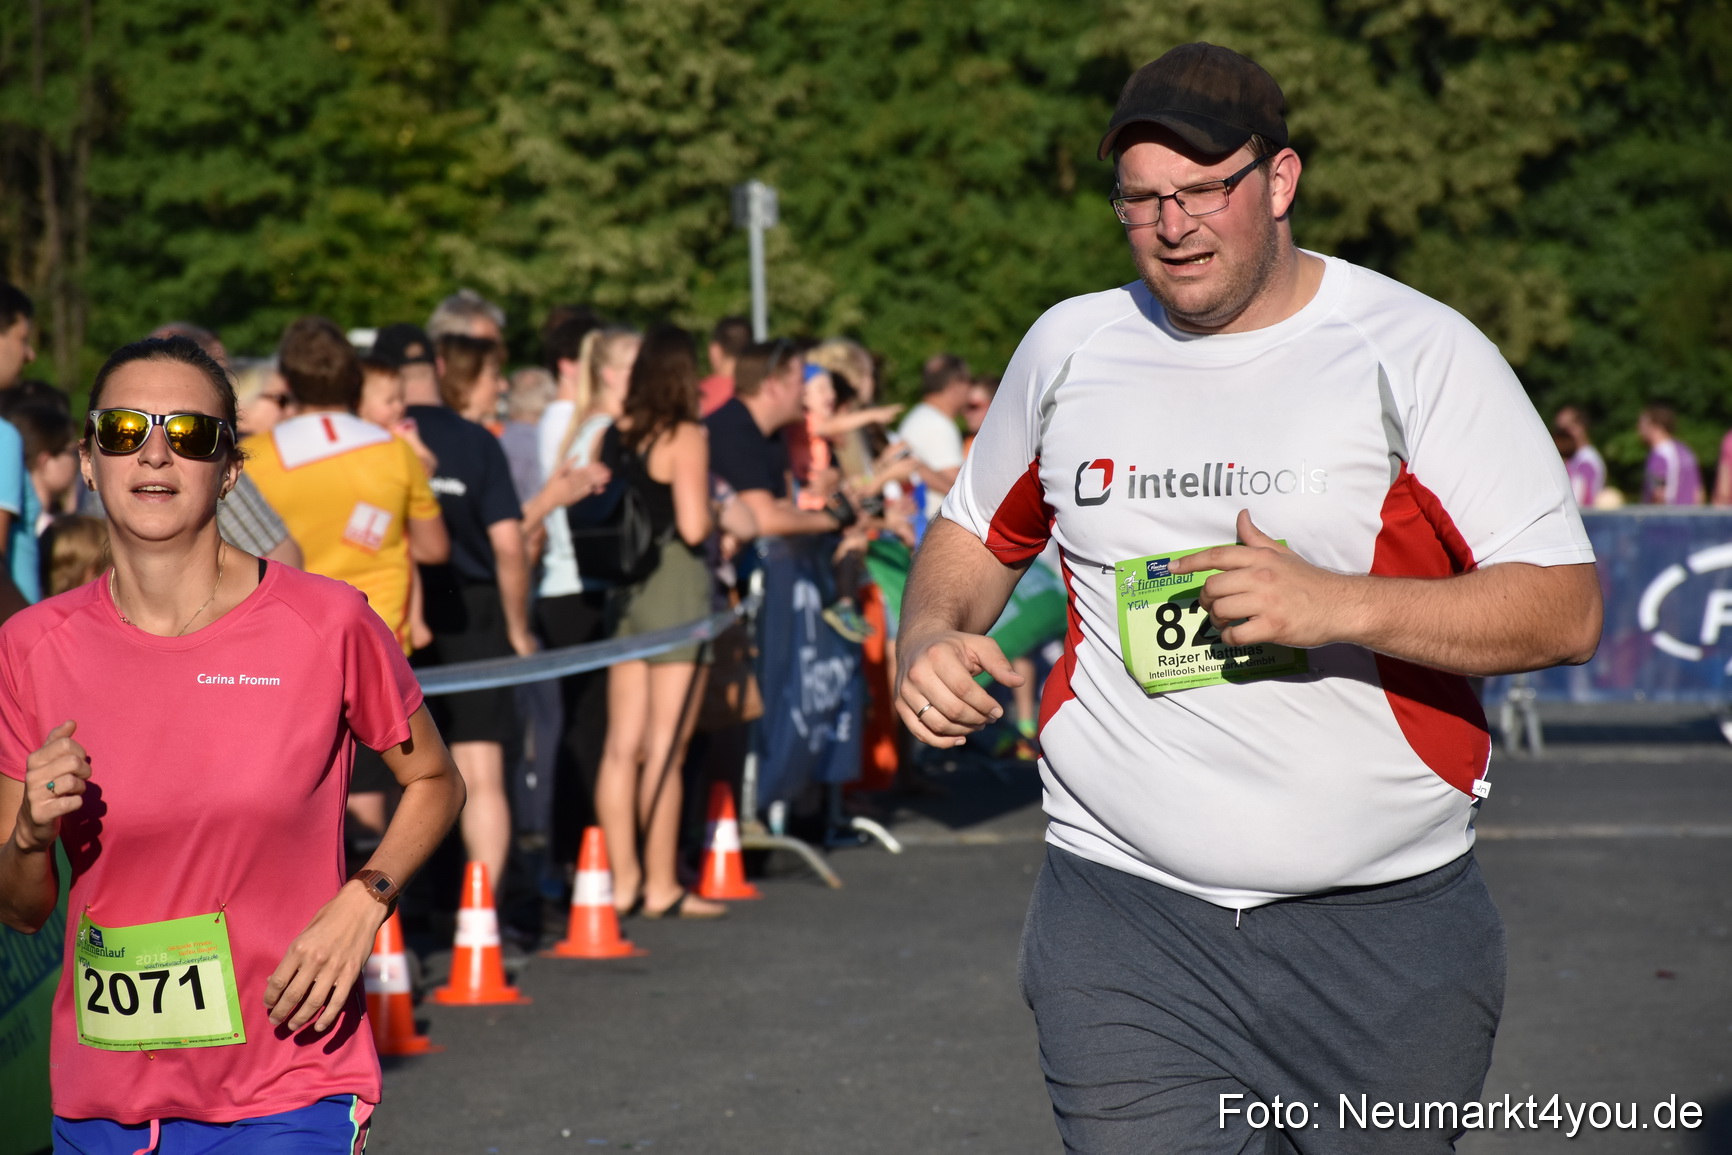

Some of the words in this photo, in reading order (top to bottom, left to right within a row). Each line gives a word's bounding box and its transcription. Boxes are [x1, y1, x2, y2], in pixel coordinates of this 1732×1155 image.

[1128, 459, 1328, 499] intellitools
[1138, 573, 1194, 590] firmenlauf
[1155, 598, 1222, 651] 82
[1149, 667, 1196, 679] Intellitools
[1198, 660, 1244, 673] Neumarkt
[1245, 656, 1276, 667] GmbH
[1158, 653, 1201, 668] Rajzer
[1204, 645, 1264, 661] Matthias
[197, 673, 235, 685] Carina
[239, 674, 280, 686] Fromm
[136, 952, 168, 966] 2018
[84, 965, 206, 1016] 2071
